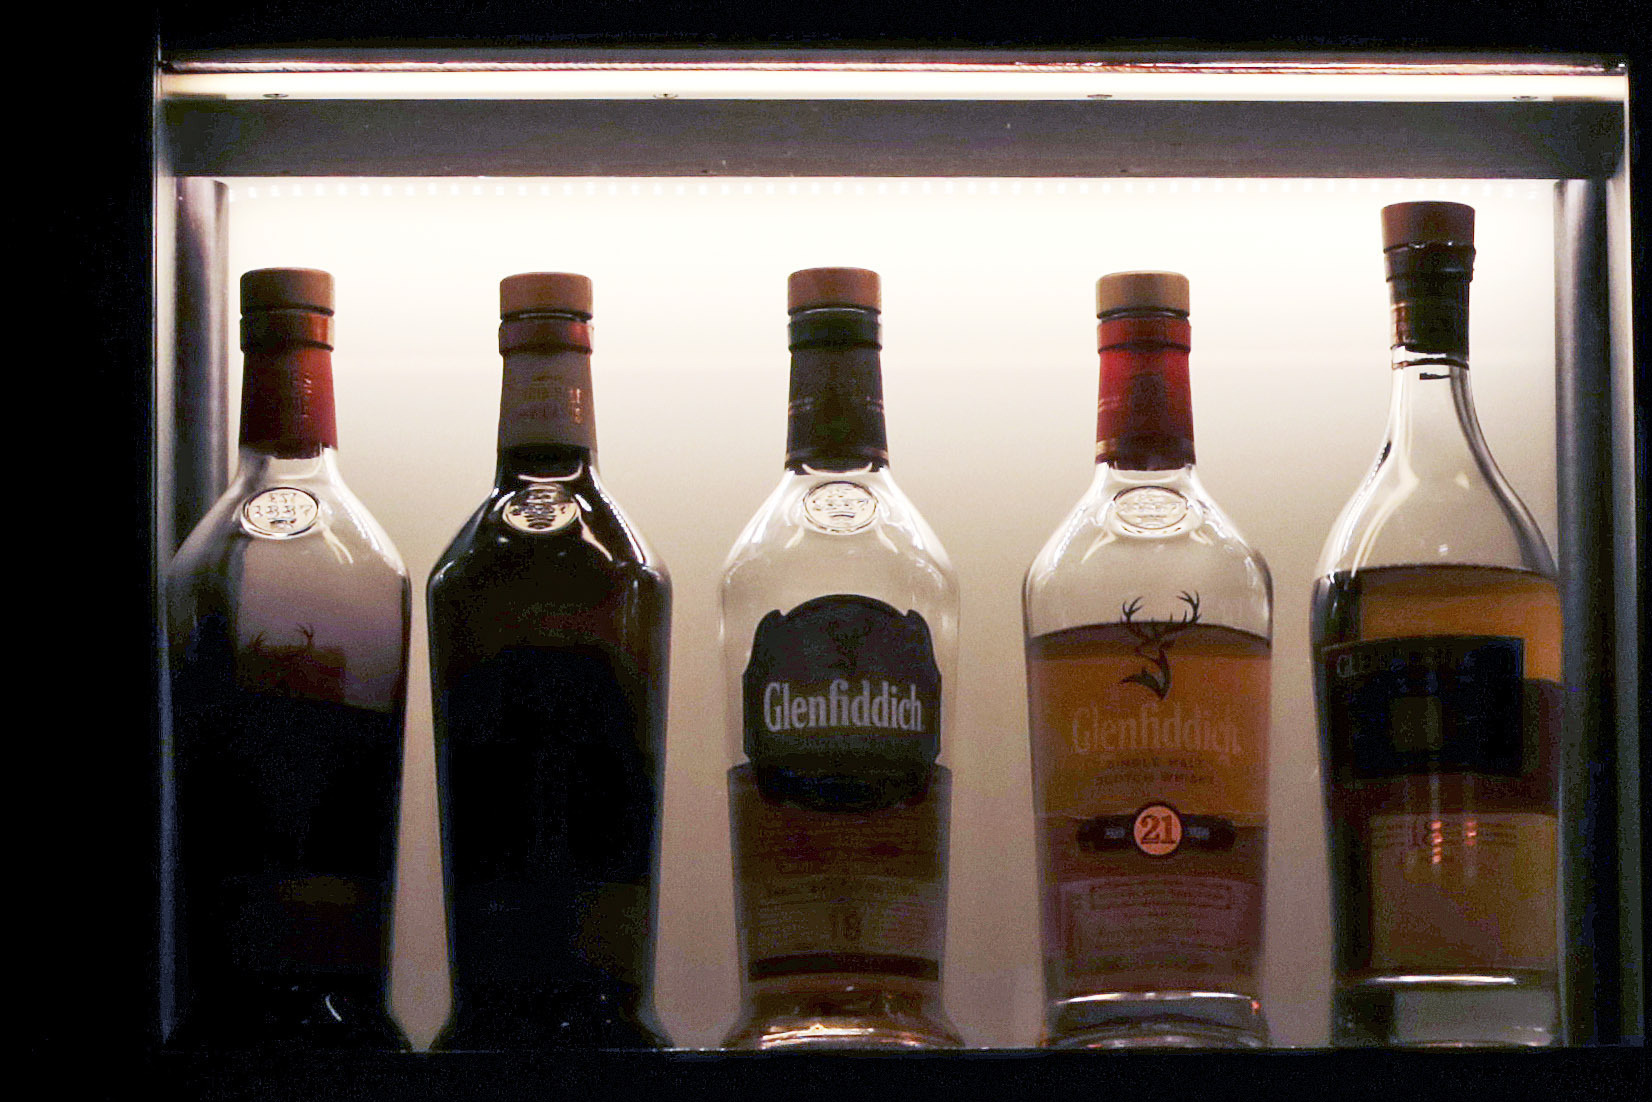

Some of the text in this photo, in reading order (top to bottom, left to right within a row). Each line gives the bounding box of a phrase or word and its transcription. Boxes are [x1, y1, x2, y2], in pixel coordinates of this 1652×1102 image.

[763, 679, 926, 733] Glenfiddich
[1072, 700, 1244, 756] Glenfiddich
[1140, 814, 1177, 845] 21
